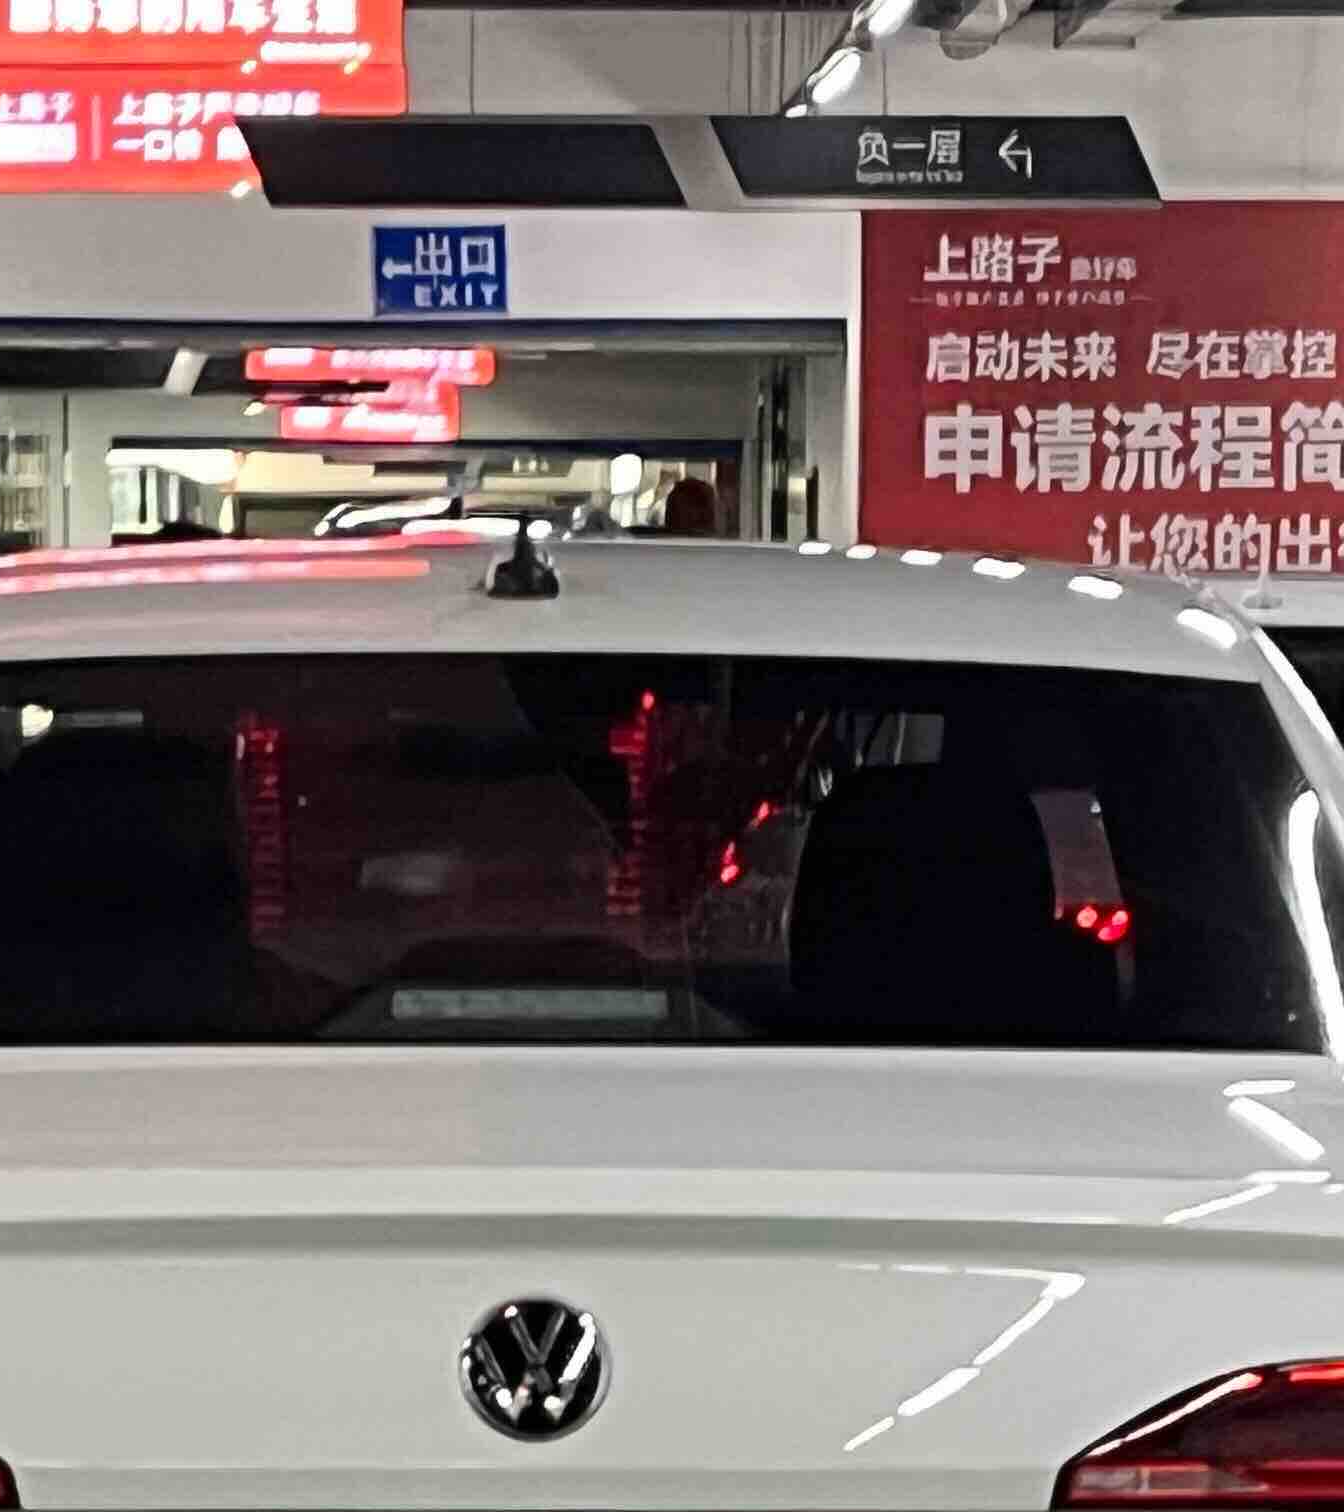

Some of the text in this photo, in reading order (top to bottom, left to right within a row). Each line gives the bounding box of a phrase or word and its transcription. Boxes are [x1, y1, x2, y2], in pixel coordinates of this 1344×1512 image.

[858, 127, 961, 166] 负一层
[414, 232, 496, 277] 出口
[923, 233, 1062, 283] 上路子
[414, 282, 498, 307] EXIT
[926, 331, 1118, 382] 启动未来
[1146, 330, 1337, 381] 尽在掌控
